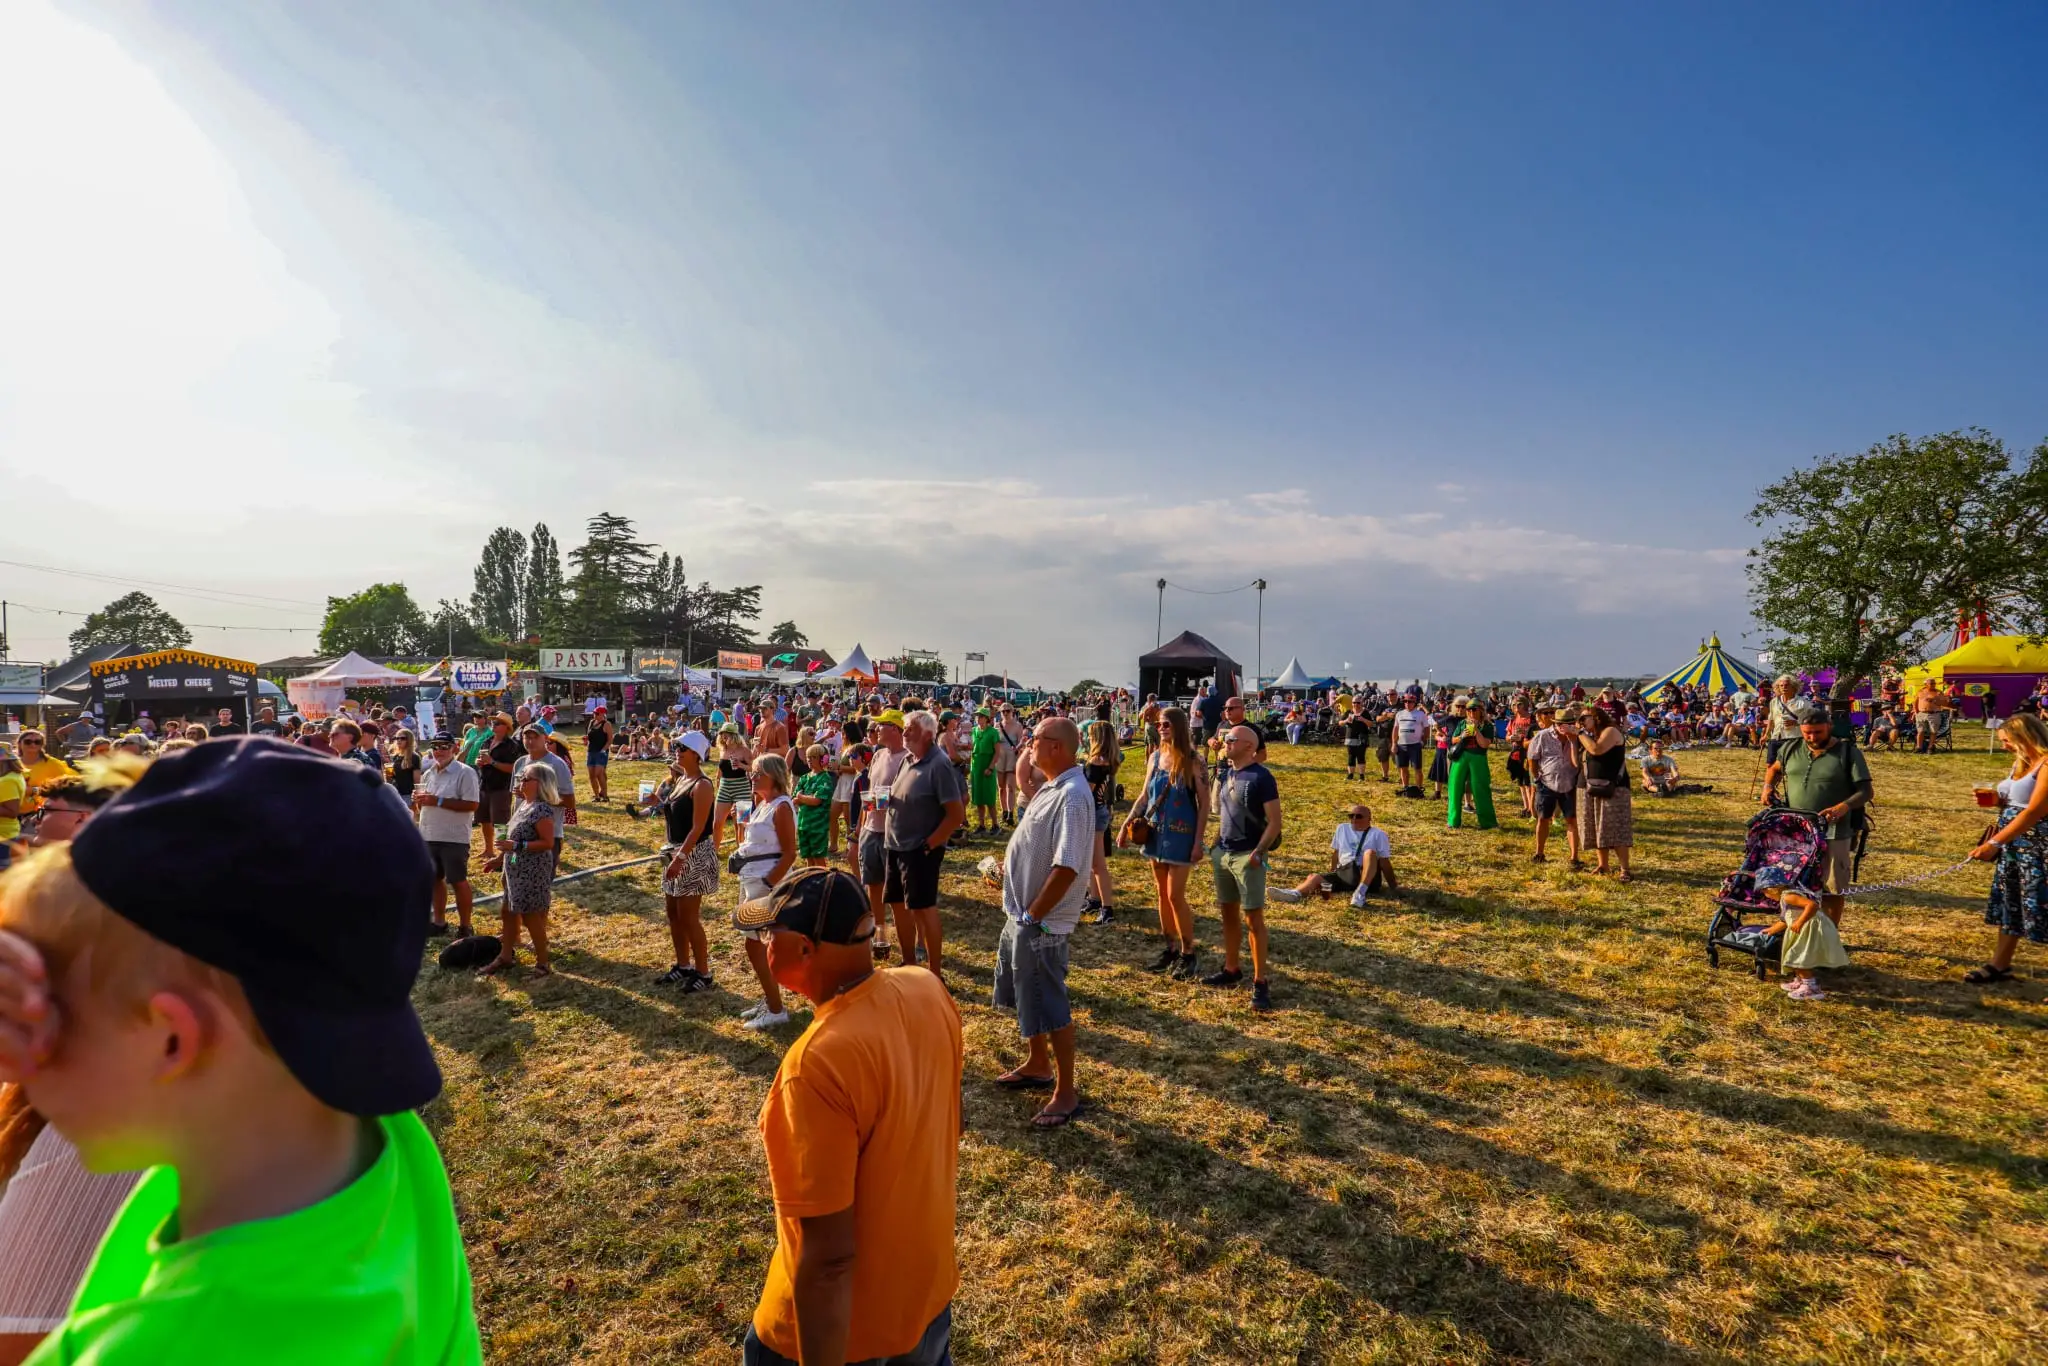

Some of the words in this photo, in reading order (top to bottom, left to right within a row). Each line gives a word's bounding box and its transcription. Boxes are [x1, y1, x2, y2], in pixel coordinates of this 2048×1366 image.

[555, 652, 613, 667] PASTA
[460, 662, 496, 673] SMASH
[148, 678, 178, 688] MELTED
[184, 678, 212, 687] CHEESE
[462, 673, 496, 682] BURGERS
[104, 678, 130, 689] CHEESE
